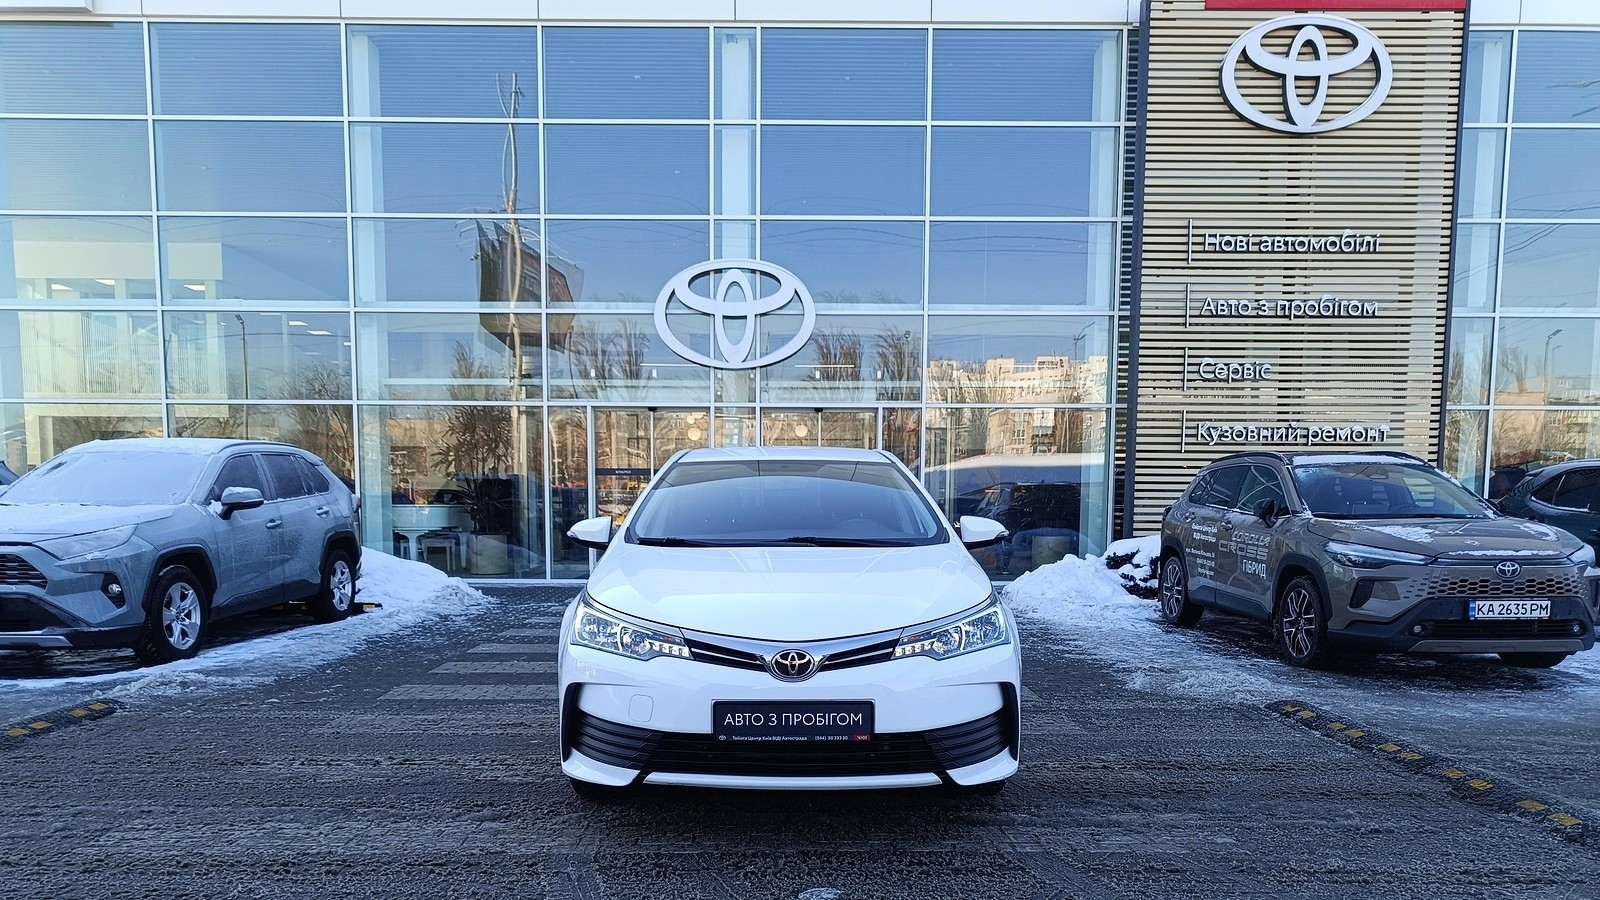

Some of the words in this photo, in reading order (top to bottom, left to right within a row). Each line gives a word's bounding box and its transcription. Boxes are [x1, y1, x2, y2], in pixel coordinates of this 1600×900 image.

[1204, 232, 1253, 252] Нові
[1259, 229, 1381, 252] автомобілі
[1200, 296, 1251, 316] Авто
[1256, 301, 1270, 316] з
[1276, 293, 1379, 320] пробігом
[1199, 357, 1272, 383] Сервіс
[1196, 421, 1300, 446] Кузовний
[1307, 424, 1391, 446] ремонт
[1231, 531, 1271, 546] COROLLA
[1218, 540, 1268, 560] CROSS
[1242, 560, 1266, 580] ГІБРИД
[1476, 604, 1495, 616] KA
[1498, 604, 1528, 616] 2635
[1530, 604, 1548, 616] PM
[724, 714, 764, 726] АВТО
[782, 713, 862, 726] ПРОБІГОМ
